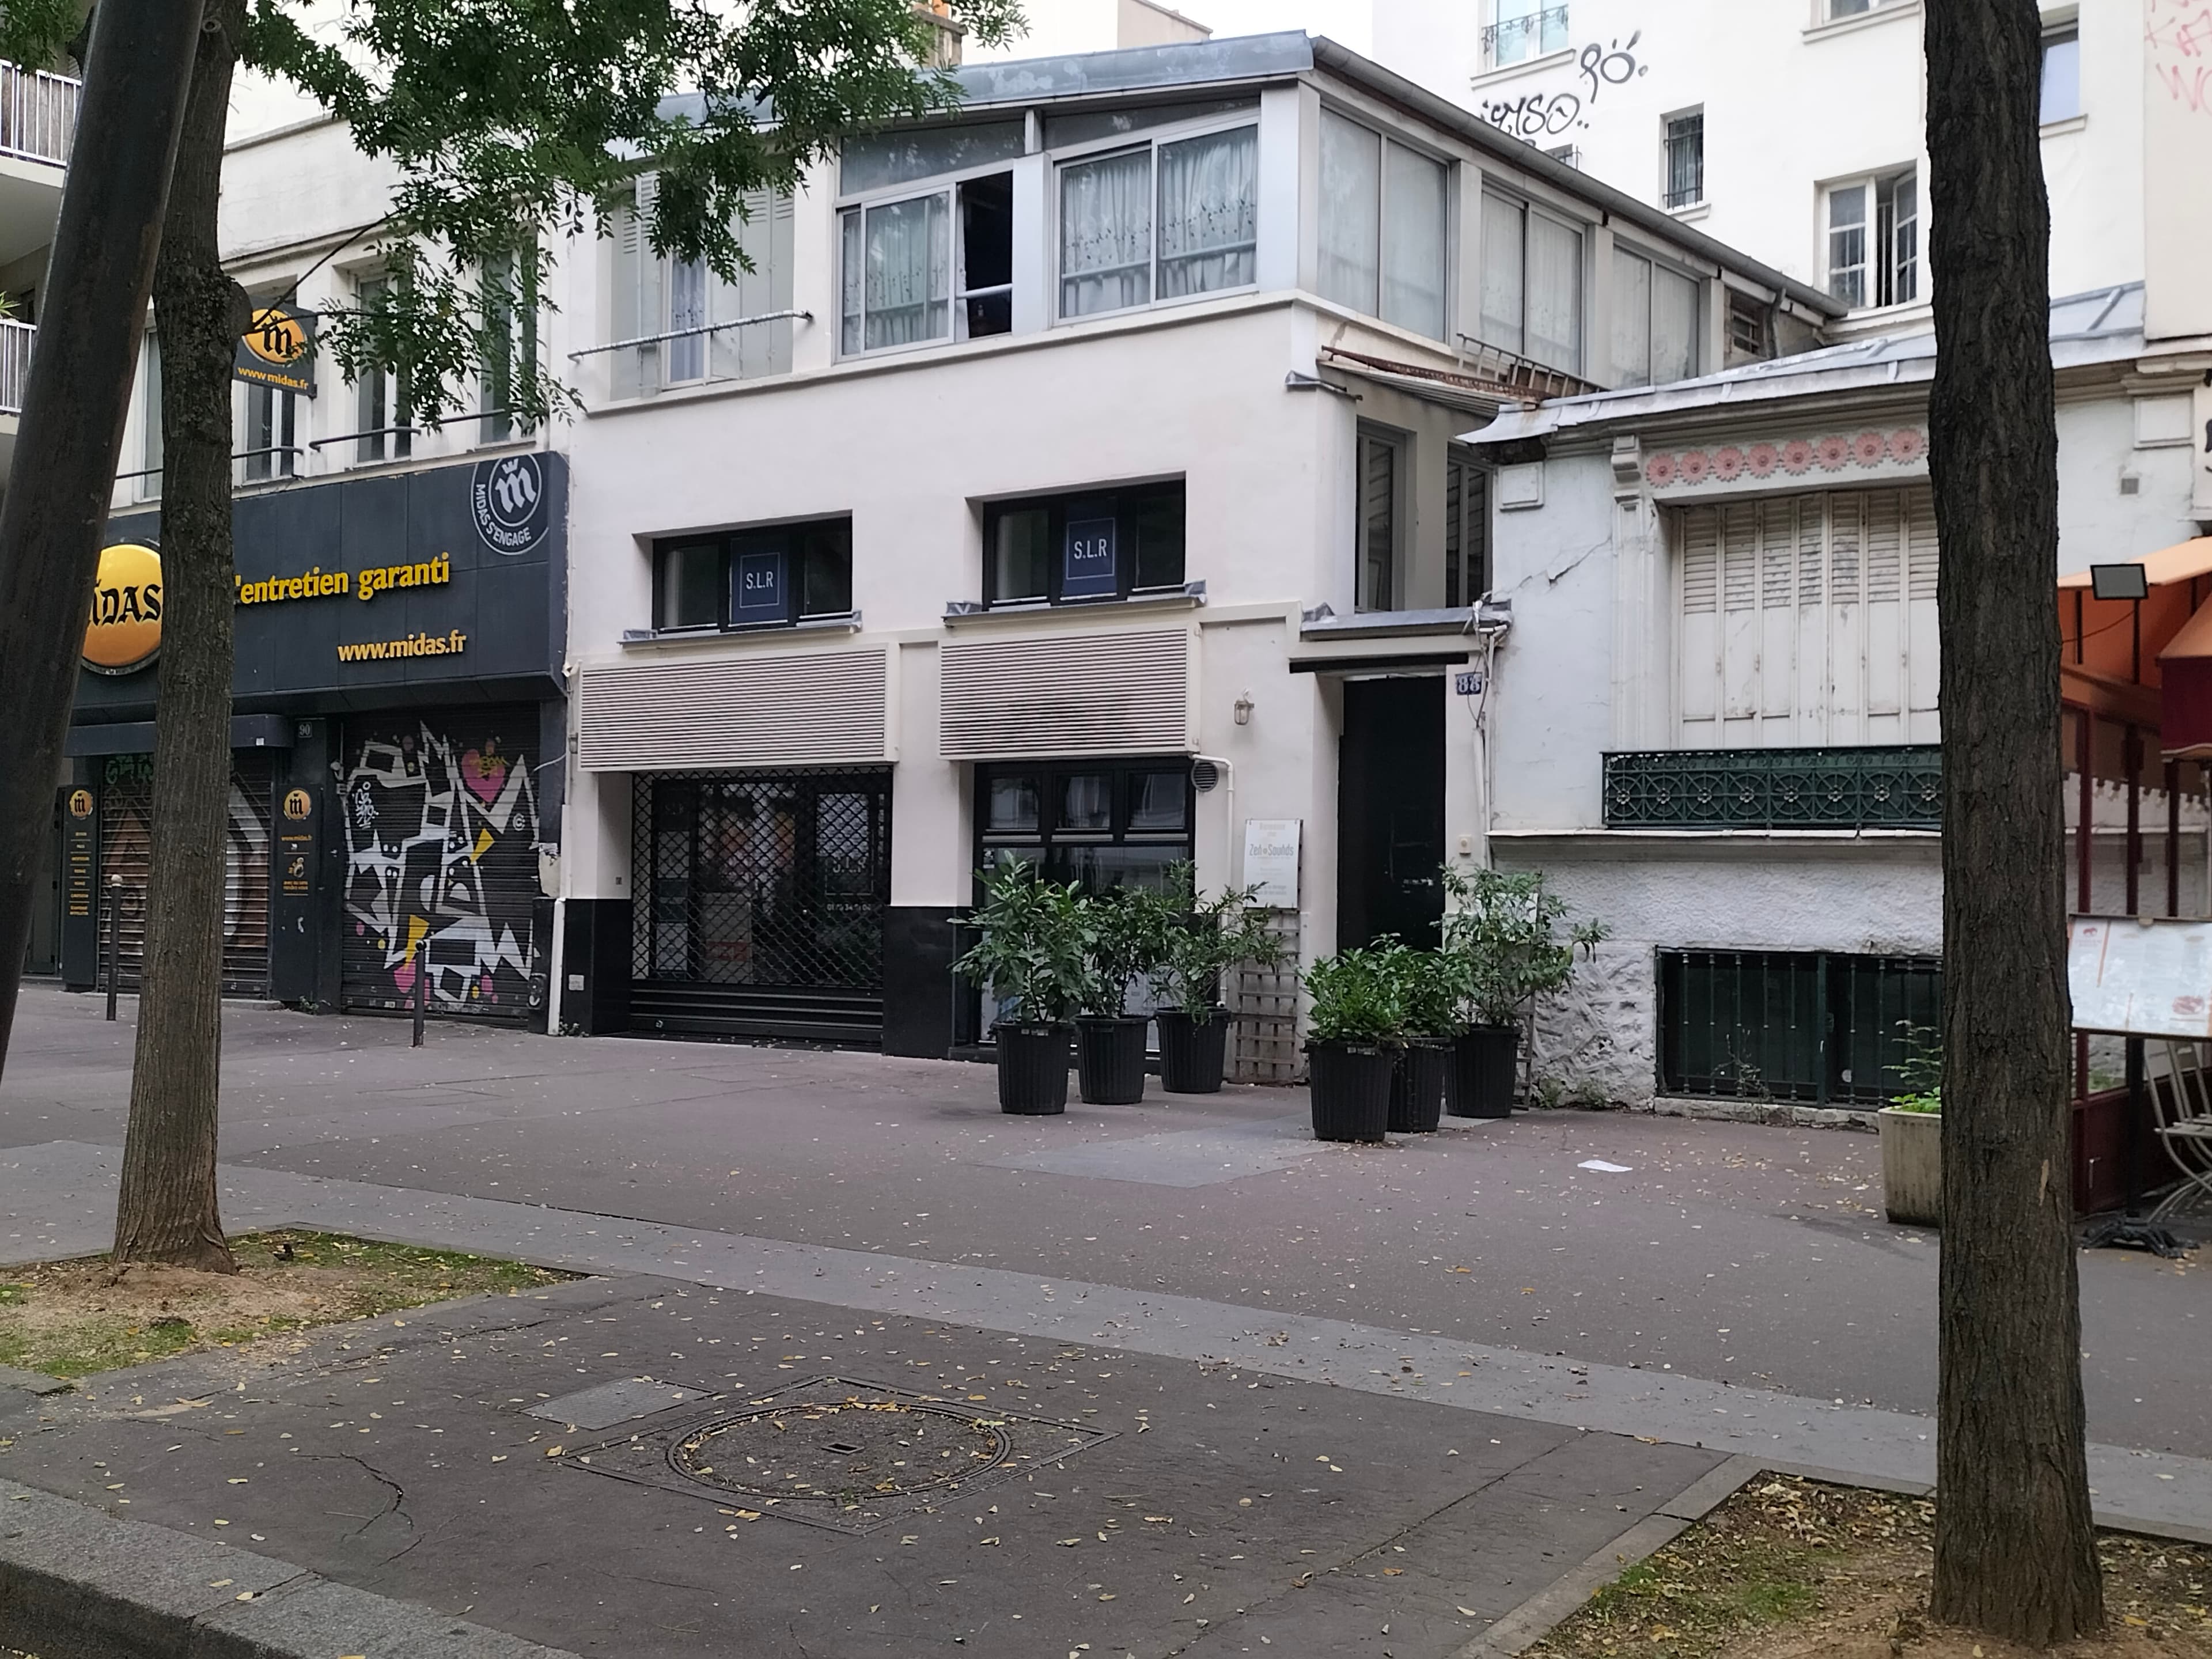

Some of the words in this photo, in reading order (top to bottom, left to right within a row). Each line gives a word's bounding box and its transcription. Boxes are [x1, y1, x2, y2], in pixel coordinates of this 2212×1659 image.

[475, 483, 491, 526] MIDAS
[486, 521, 532, 547] S'ENGAGE
[1073, 539, 1107, 559] S.L.R
[235, 566, 349, 604] 'entretien
[358, 552, 449, 600] garanti
[746, 571, 773, 589] S.L.R
[337, 629, 467, 662] www.midas.fr
[299, 724, 310, 736] 90
